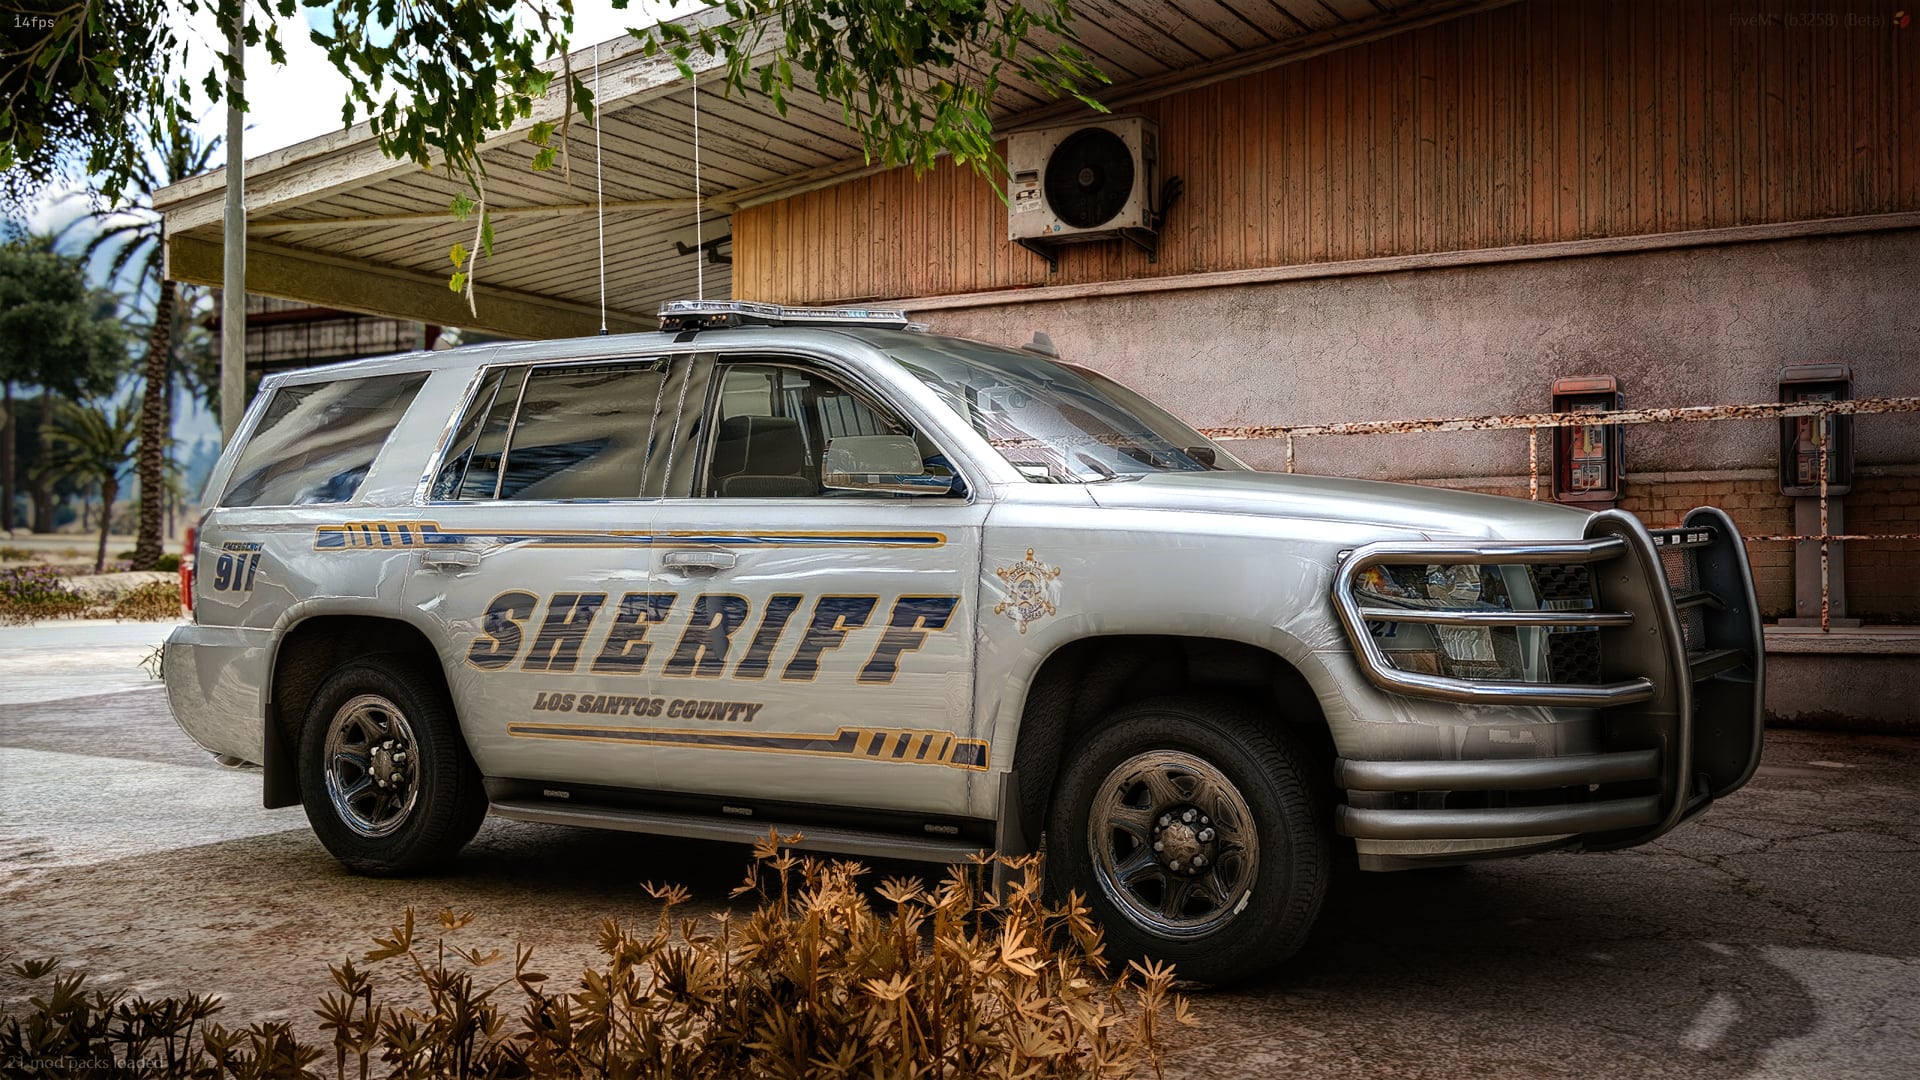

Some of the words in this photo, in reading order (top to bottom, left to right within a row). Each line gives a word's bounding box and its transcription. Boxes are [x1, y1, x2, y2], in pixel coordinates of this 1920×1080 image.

[214, 552, 262, 592] 911
[463, 588, 962, 685] SHERIFF
[532, 690, 577, 712] LOS
[575, 694, 665, 719] SANTOS
[666, 698, 764, 723] COUNTY
